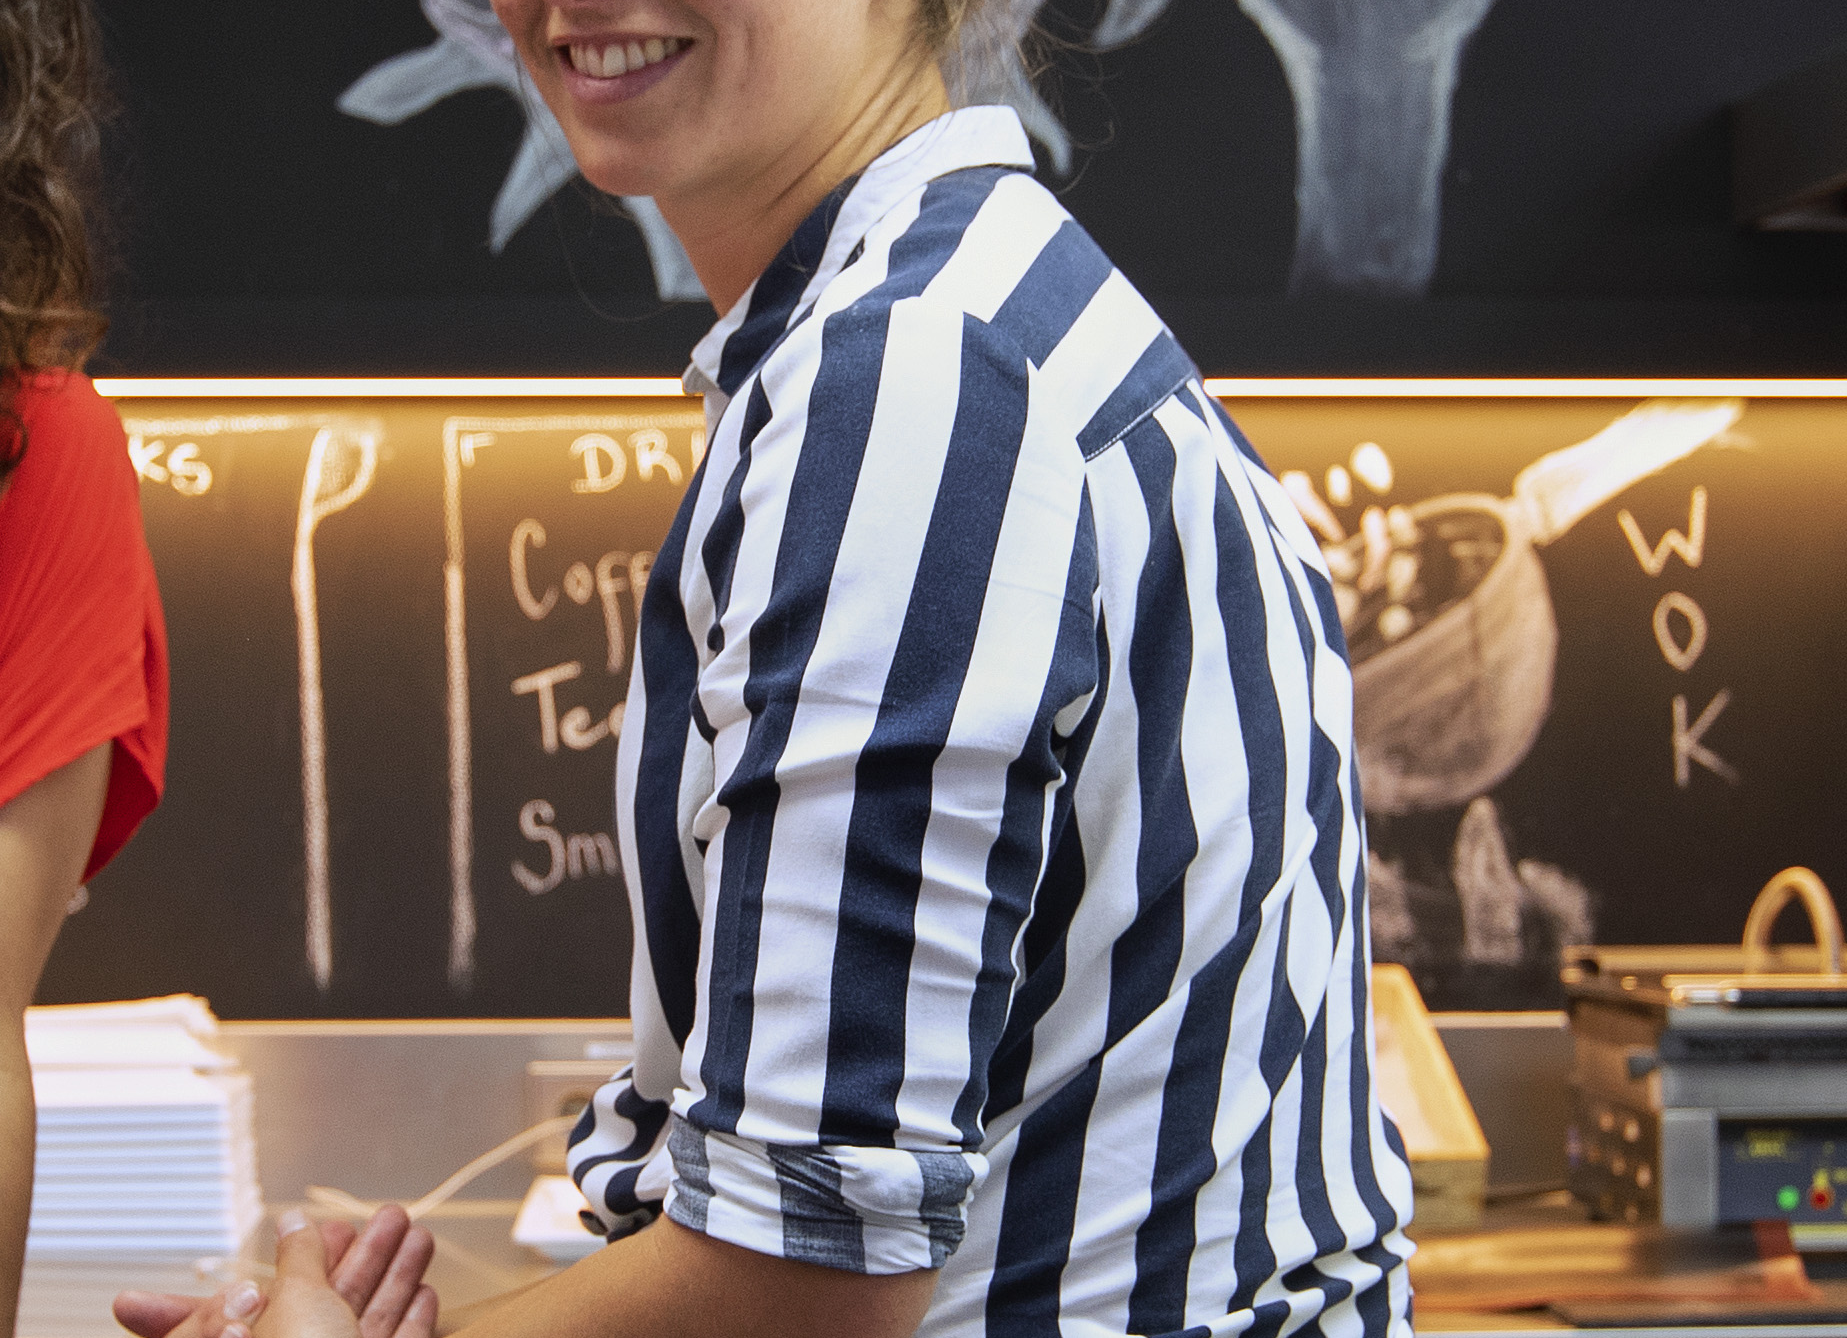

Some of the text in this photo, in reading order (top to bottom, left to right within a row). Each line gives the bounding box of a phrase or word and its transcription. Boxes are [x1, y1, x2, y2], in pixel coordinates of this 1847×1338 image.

[569, 428, 706, 495] DRI
[509, 518, 660, 674] Coff
[1617, 486, 1742, 789] WOK
[510, 798, 619, 895] Sm
